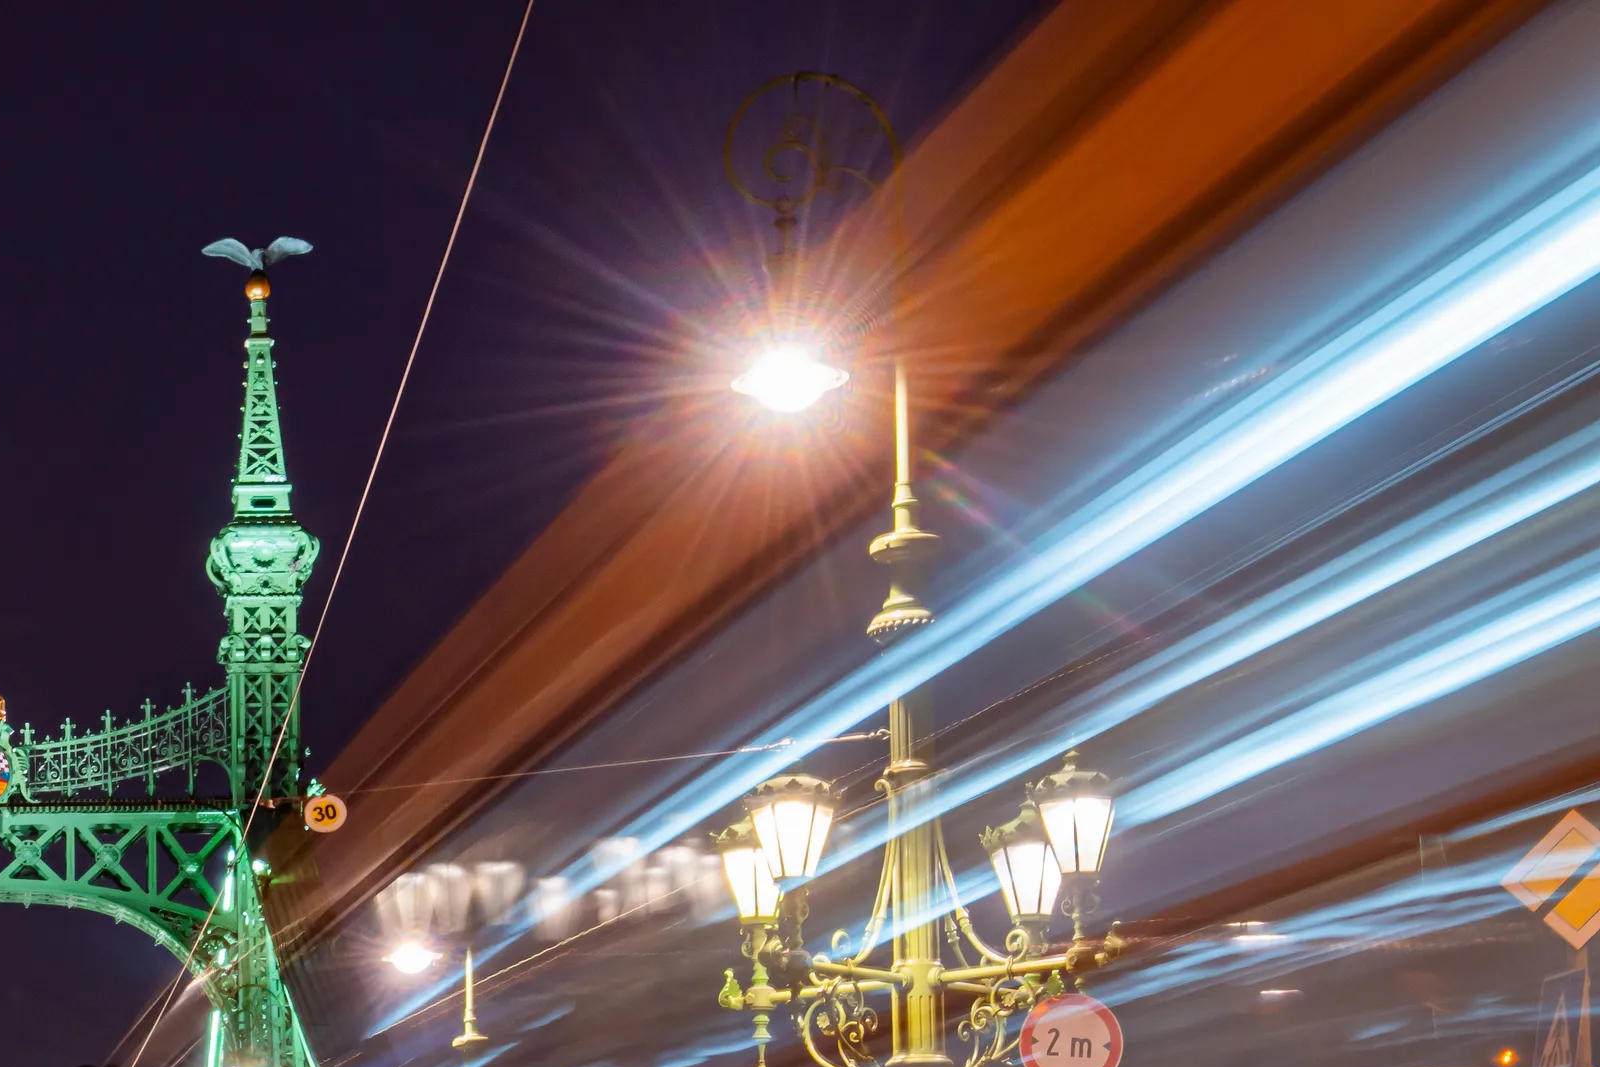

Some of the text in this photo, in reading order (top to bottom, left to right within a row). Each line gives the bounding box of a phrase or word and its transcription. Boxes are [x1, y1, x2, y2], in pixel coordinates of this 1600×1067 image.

[312, 804, 337, 822] 30
[1046, 1028, 1092, 1058] 2 m
